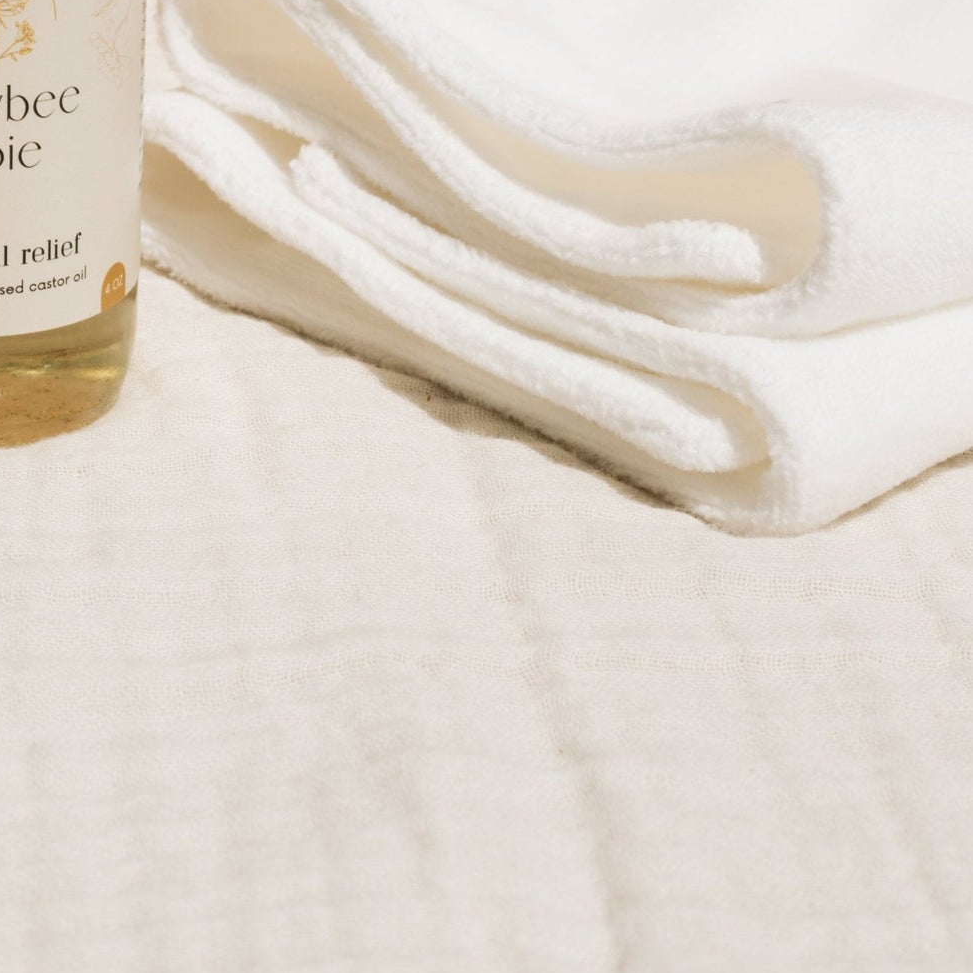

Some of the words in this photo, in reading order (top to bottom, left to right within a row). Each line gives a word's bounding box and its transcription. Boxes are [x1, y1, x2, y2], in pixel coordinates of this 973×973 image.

[21, 231, 82, 265] relief
[29, 275, 71, 293] castor
[73, 265, 87, 283] oil
[105, 282, 111, 294] 4
